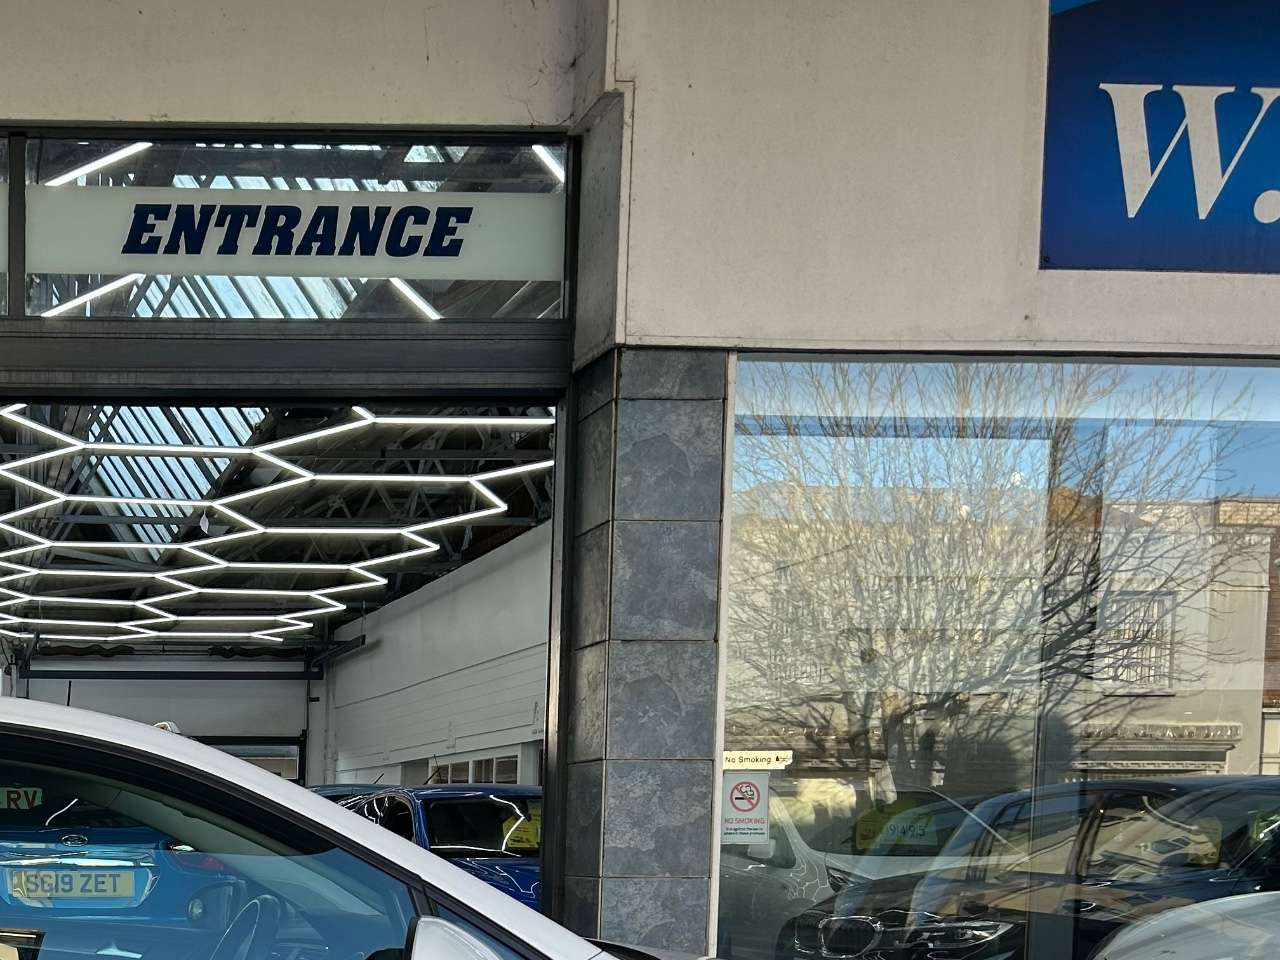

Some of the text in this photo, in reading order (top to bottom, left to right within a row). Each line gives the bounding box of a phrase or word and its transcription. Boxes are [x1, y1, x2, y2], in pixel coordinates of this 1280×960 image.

[120, 203, 474, 257] ENTRANCE
[738, 756, 771, 765] Smoking
[80, 874, 121, 892] ZET
